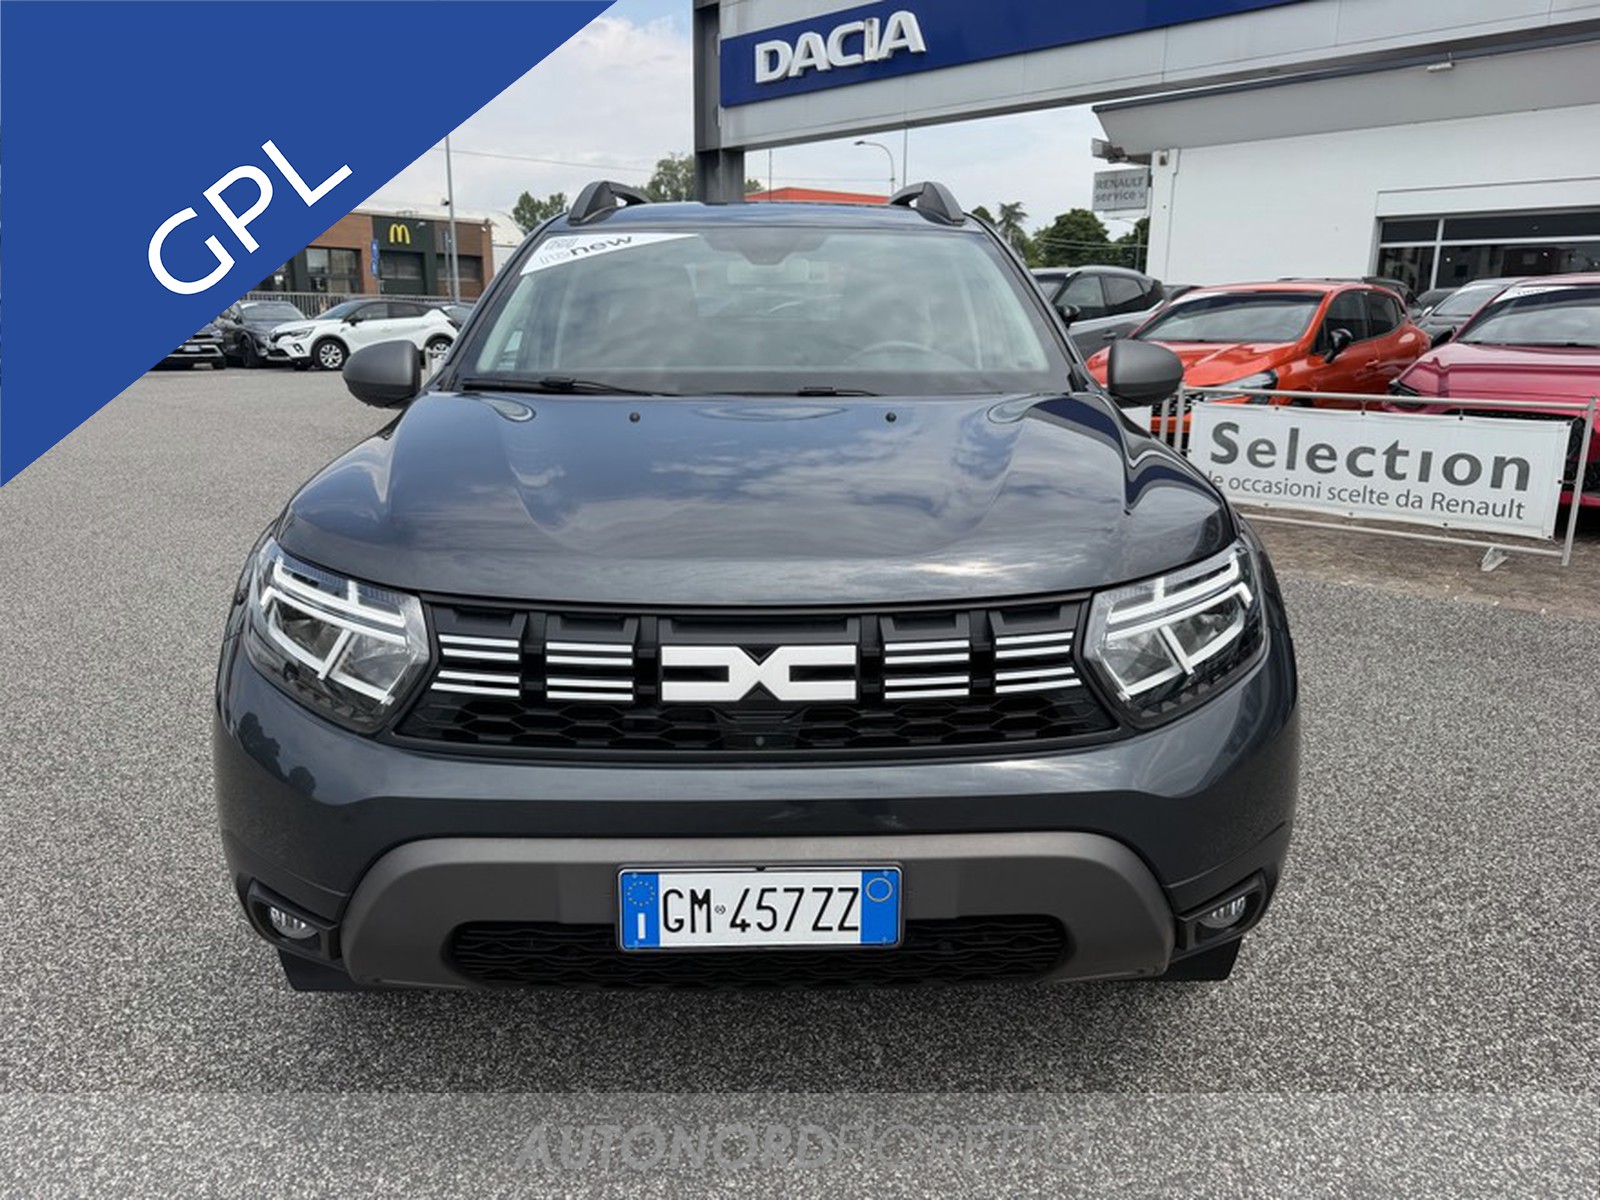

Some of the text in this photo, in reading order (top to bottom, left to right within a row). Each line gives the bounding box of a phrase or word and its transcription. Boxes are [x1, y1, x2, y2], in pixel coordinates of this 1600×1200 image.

[755, 10, 926, 83] DACIA
[1095, 177, 1144, 189] RENAULT
[1228, 477, 1322, 499] occasioni
[1327, 485, 1389, 506] scelte
[1395, 489, 1423, 509] da
[1430, 492, 1525, 520] Renault
